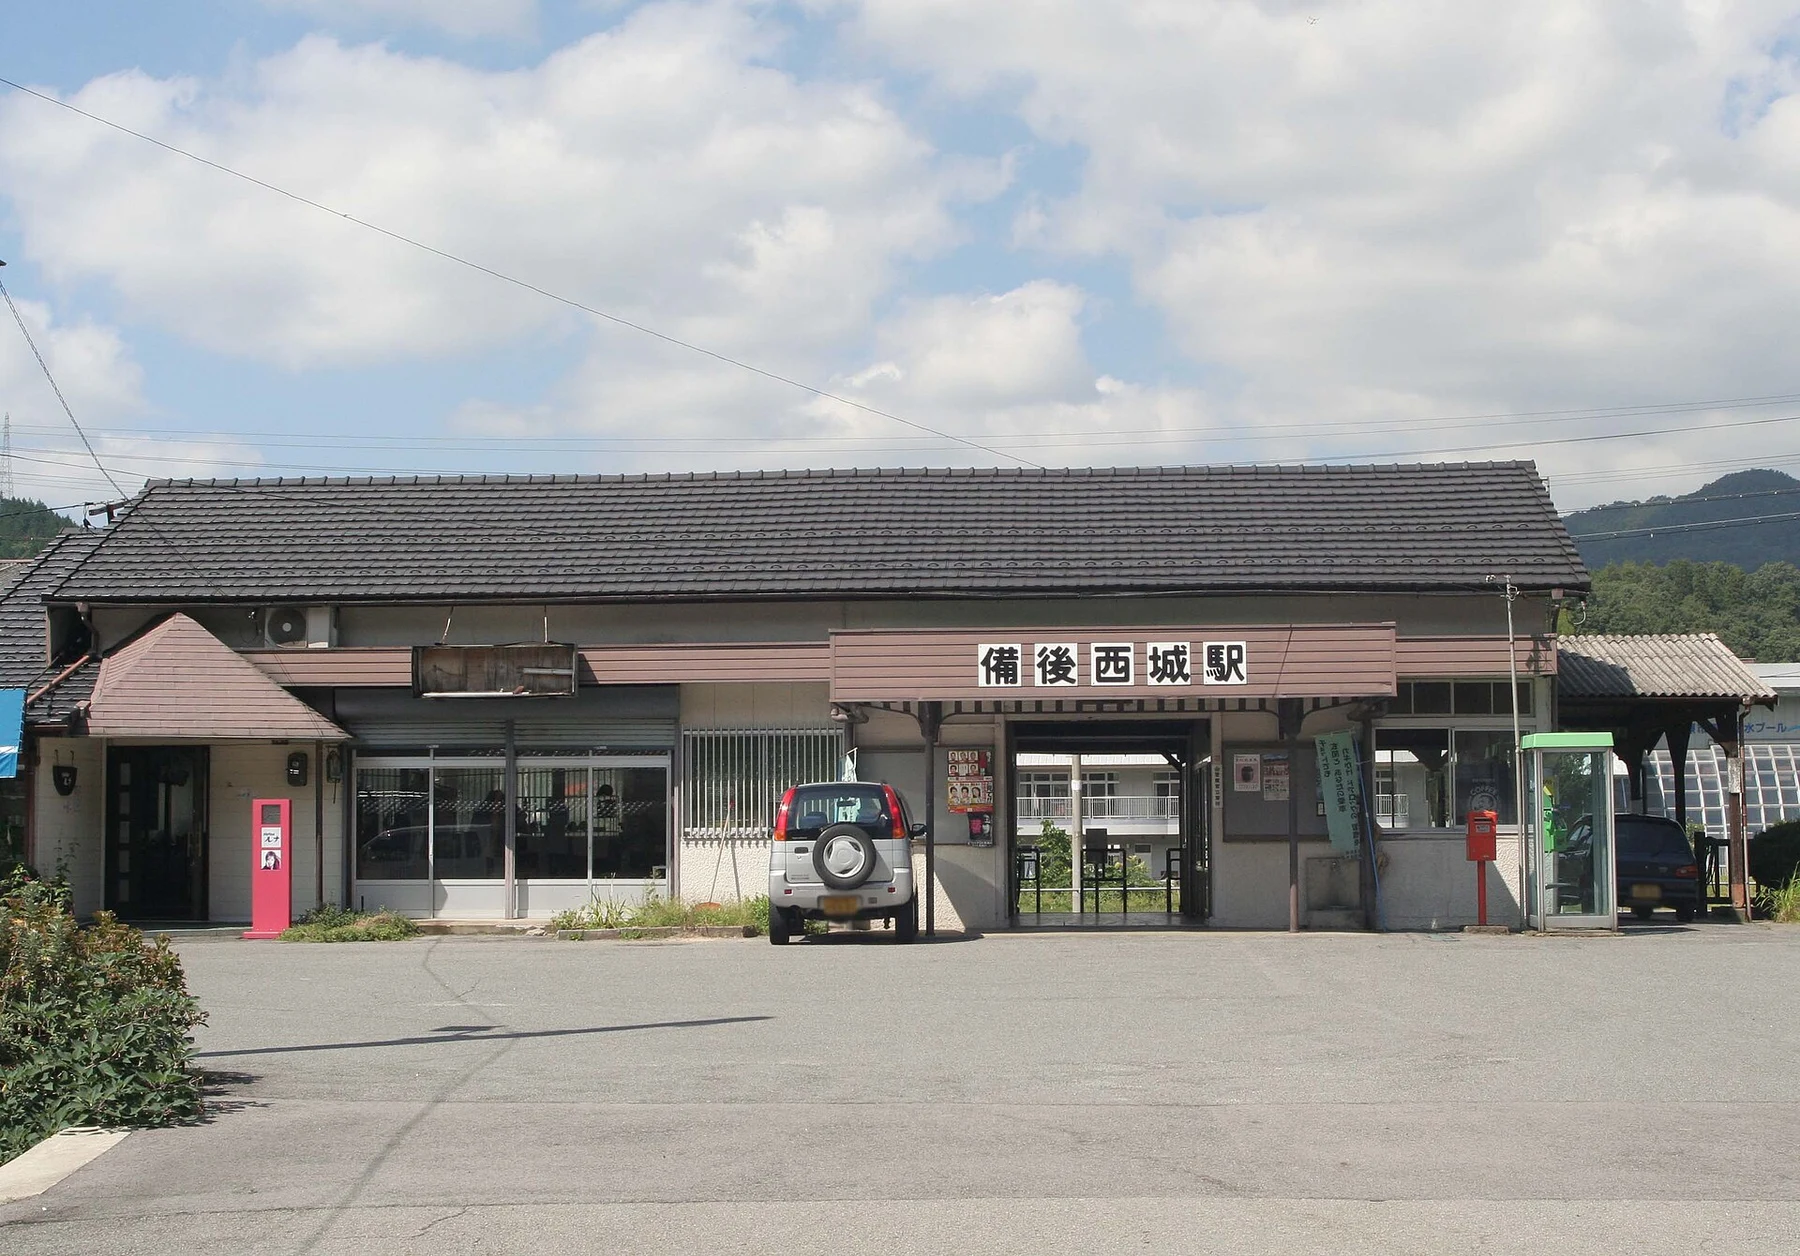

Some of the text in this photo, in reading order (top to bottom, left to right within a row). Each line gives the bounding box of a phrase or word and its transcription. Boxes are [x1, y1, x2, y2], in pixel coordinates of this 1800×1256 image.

[980, 645, 1244, 684] 備後西城駅
